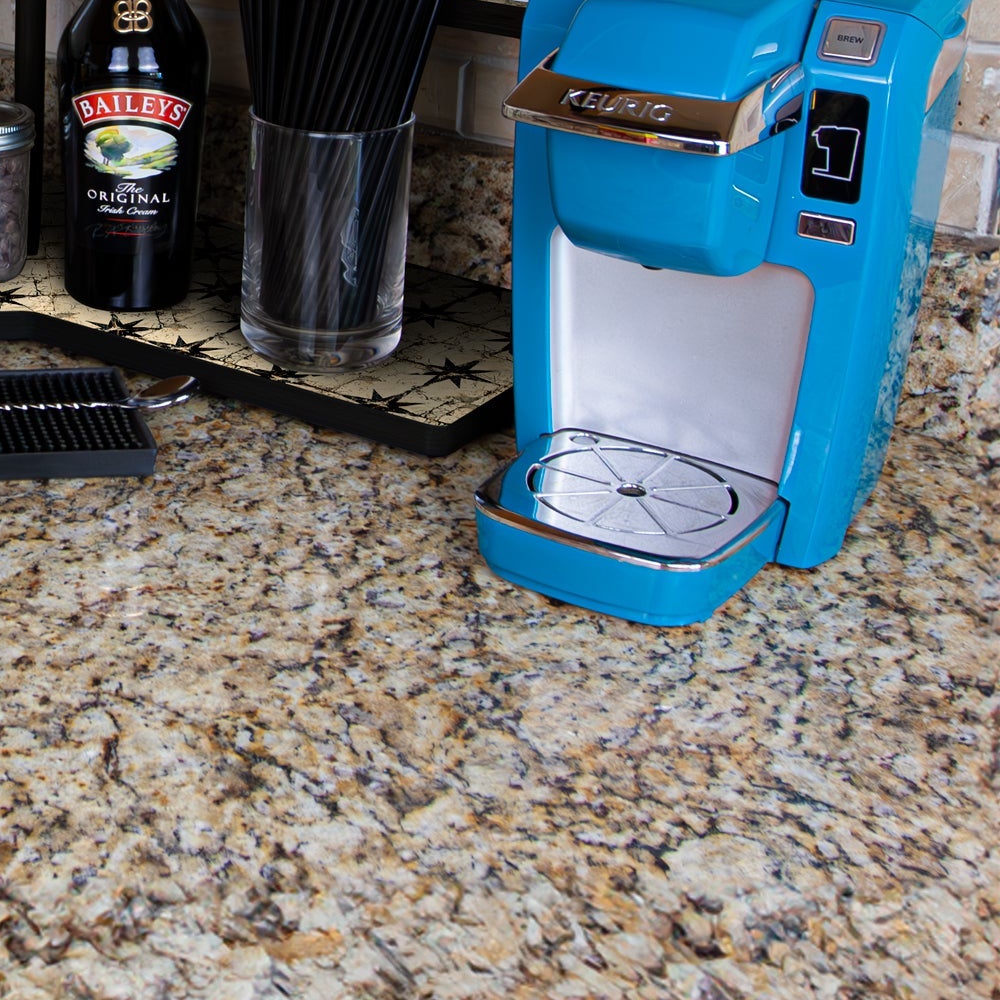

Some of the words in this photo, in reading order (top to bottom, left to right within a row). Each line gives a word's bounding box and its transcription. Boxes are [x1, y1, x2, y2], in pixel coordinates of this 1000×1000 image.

[836, 34, 865, 44] BREW
[79, 95, 184, 121] BAILEYS
[560, 88, 674, 122] KEURIG
[115, 183, 144, 194] The
[87, 189, 170, 204] ORIGINAL
[97, 204, 124, 215] Irish
[126, 206, 158, 216] Cream
